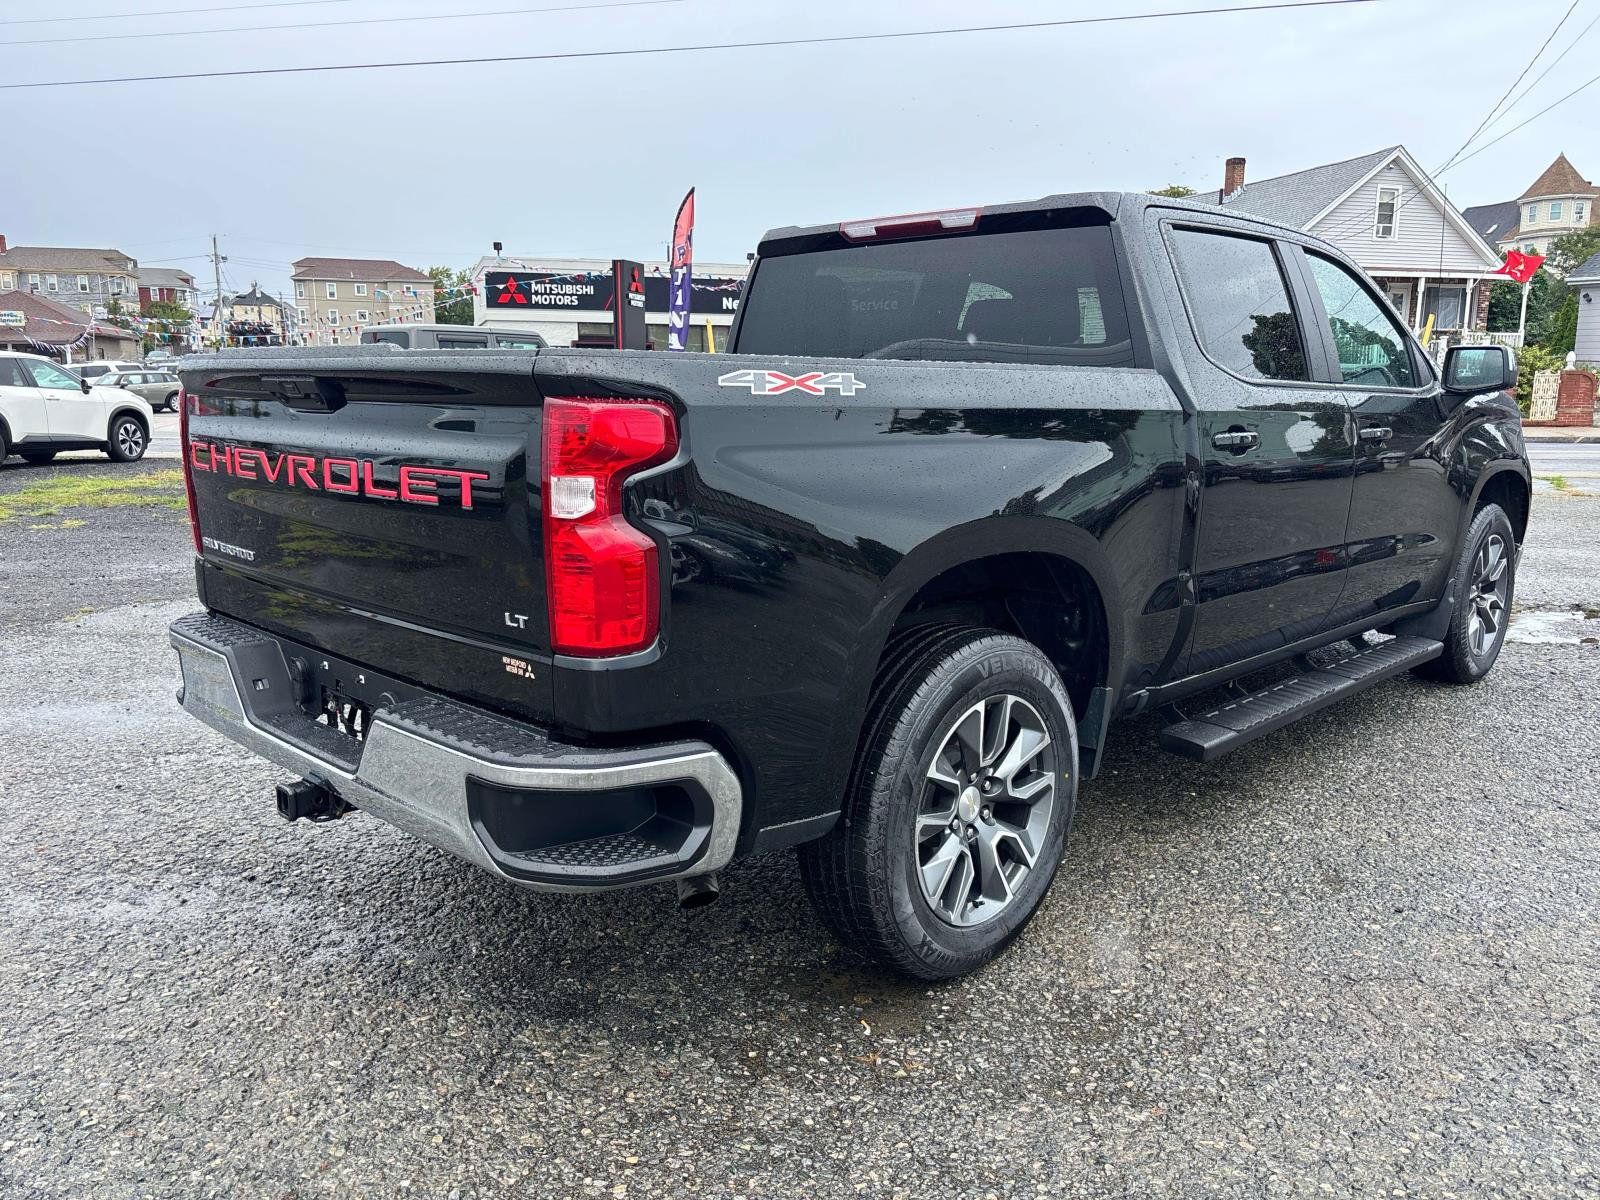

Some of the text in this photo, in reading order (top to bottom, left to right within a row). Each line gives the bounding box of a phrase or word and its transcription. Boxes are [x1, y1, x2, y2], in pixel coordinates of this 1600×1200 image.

[531, 281, 594, 295] MITSUBISHI
[531, 295, 578, 305] MOTORS
[190, 441, 490, 510] CHEVROLET
[202, 536, 256, 561] SILVERADO
[504, 612, 529, 629] LT
